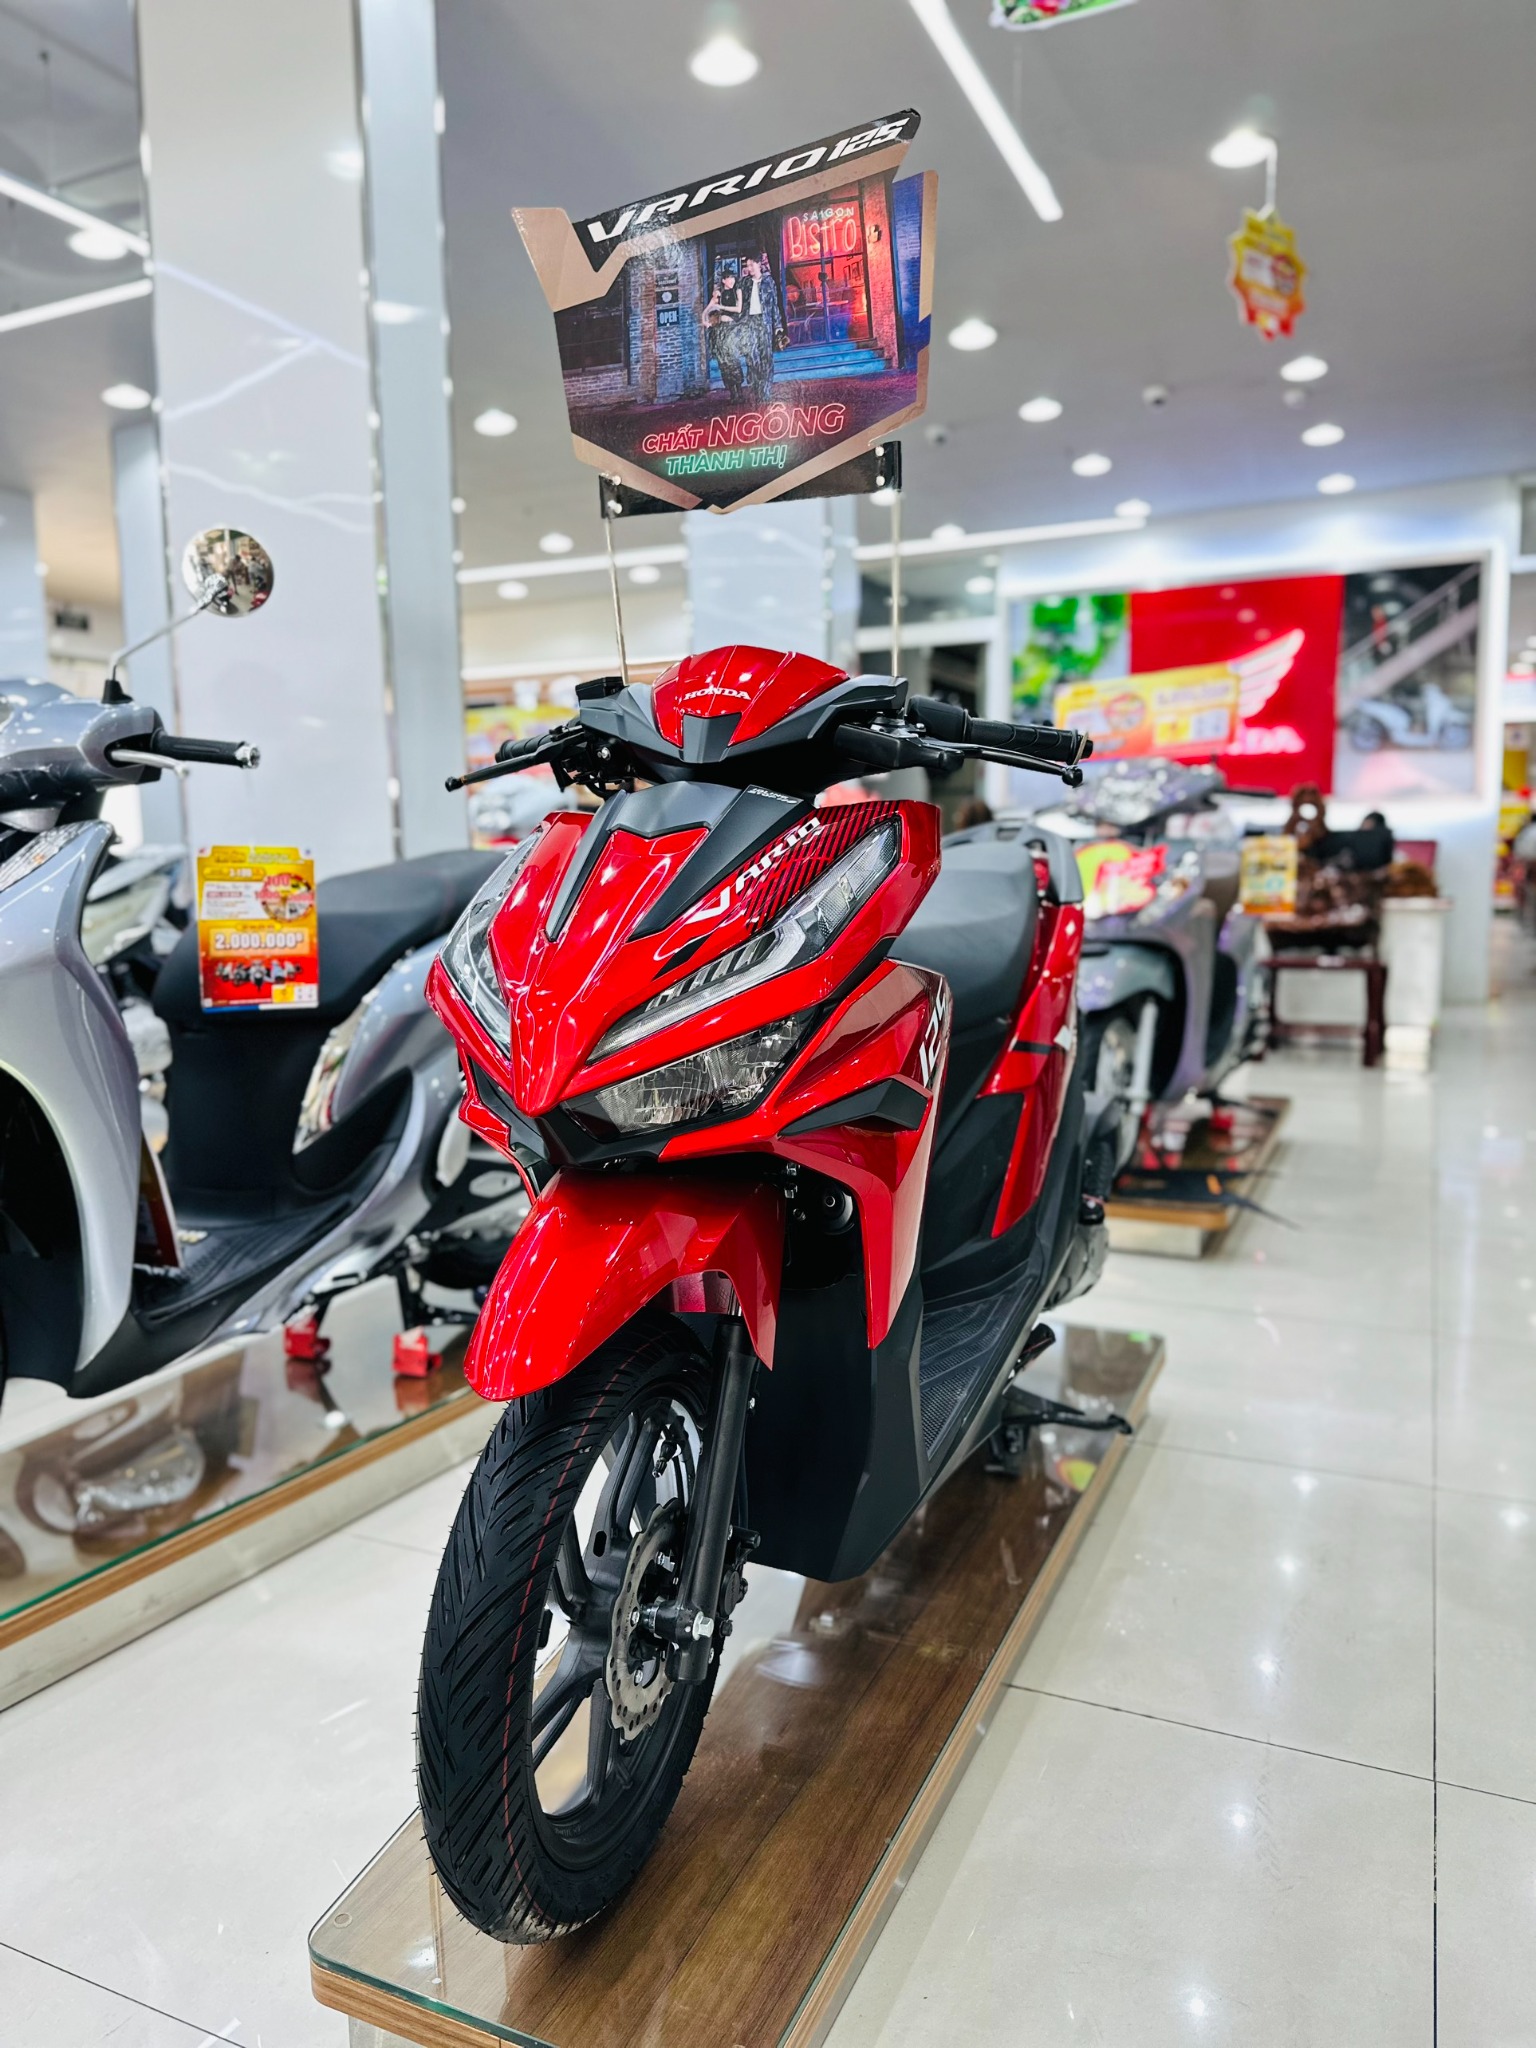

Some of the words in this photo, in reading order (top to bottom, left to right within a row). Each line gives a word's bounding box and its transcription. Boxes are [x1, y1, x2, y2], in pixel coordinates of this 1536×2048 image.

[587, 146, 828, 243] VARIO
[826, 117, 911, 162] 125
[803, 206, 855, 222] SAIGON
[659, 310, 678, 324] OPEN
[642, 424, 704, 454] CHẤT
[708, 402, 846, 447] NGÔNG
[666, 449, 745, 476] THÀNH
[749, 444, 789, 469] THỊ
[683, 687, 752, 701] HONDA
[683, 816, 821, 926] VARIO
